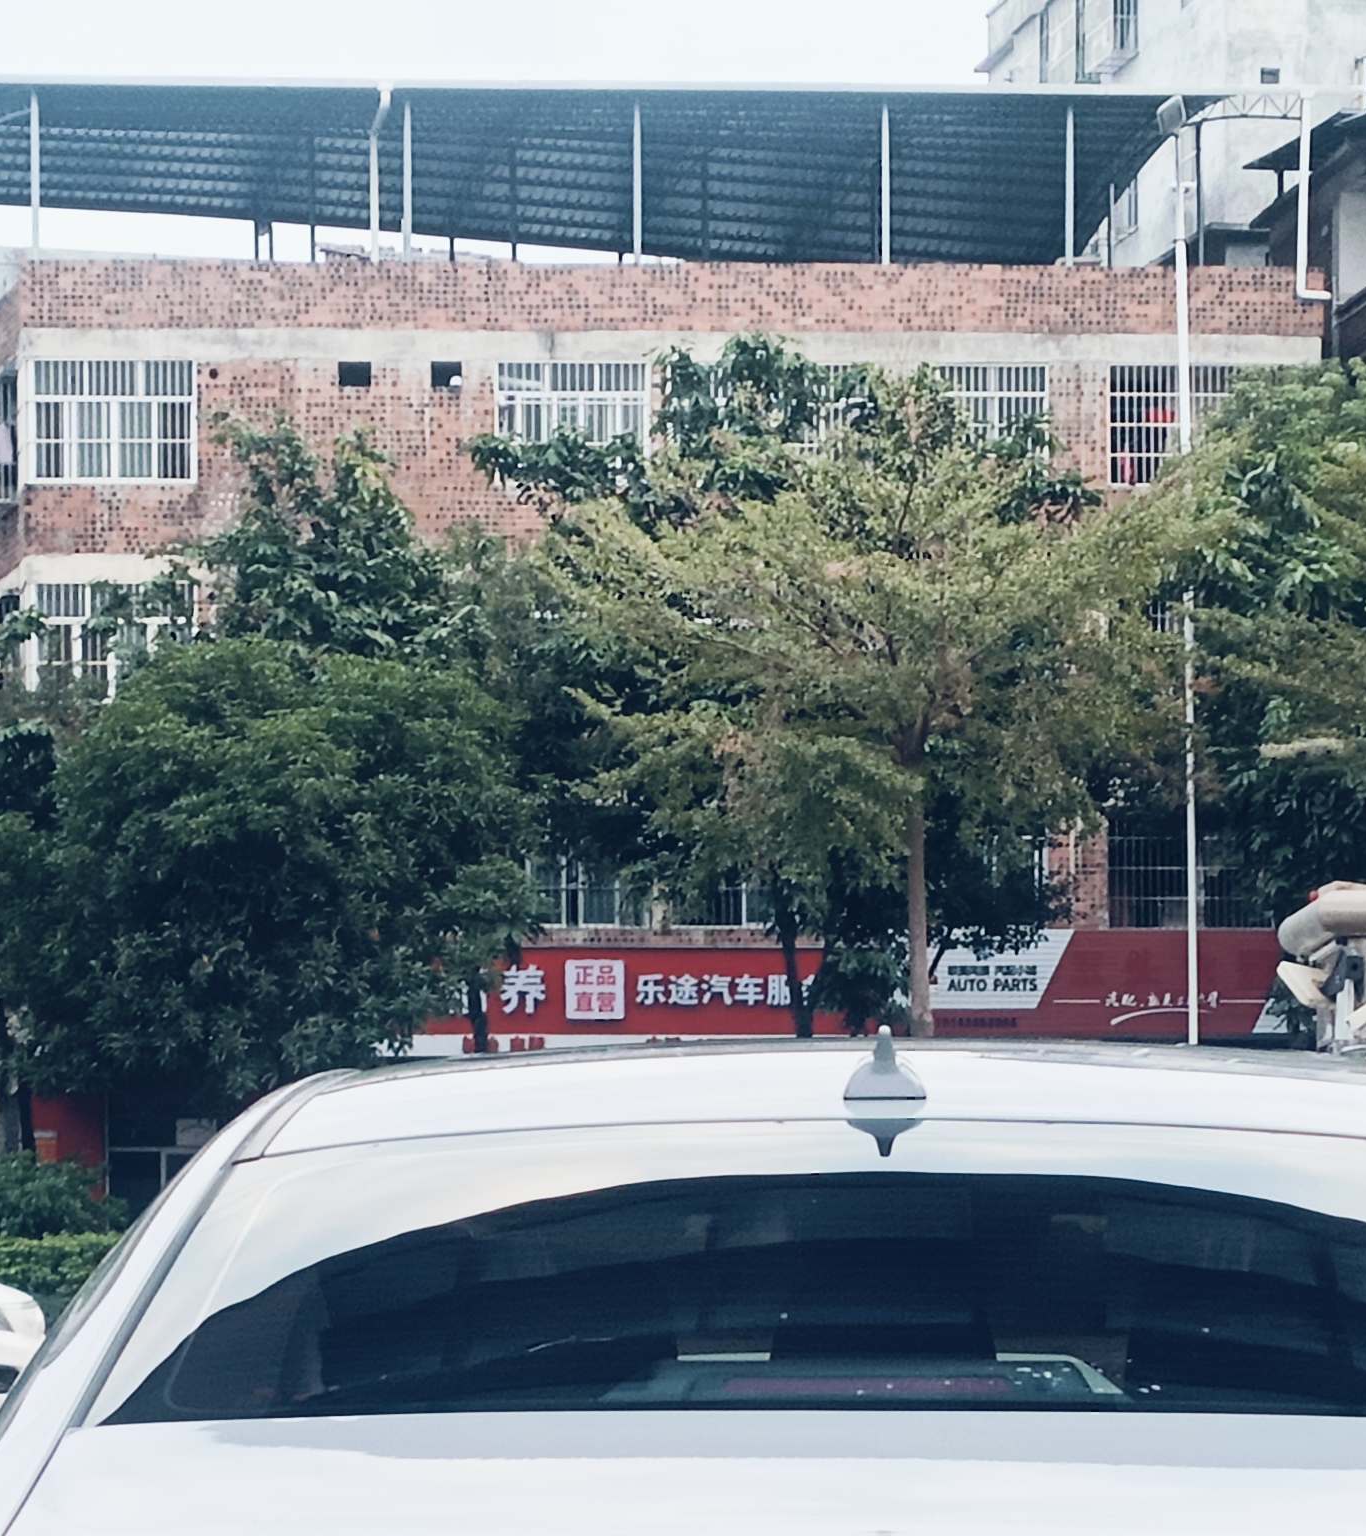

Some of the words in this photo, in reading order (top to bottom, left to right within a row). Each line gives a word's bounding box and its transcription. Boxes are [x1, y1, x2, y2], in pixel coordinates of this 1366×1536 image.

[574, 965, 617, 986] 正品
[947, 979, 987, 992] AUTO
[993, 979, 1038, 992] PARTS
[574, 991, 617, 1013] 直营
